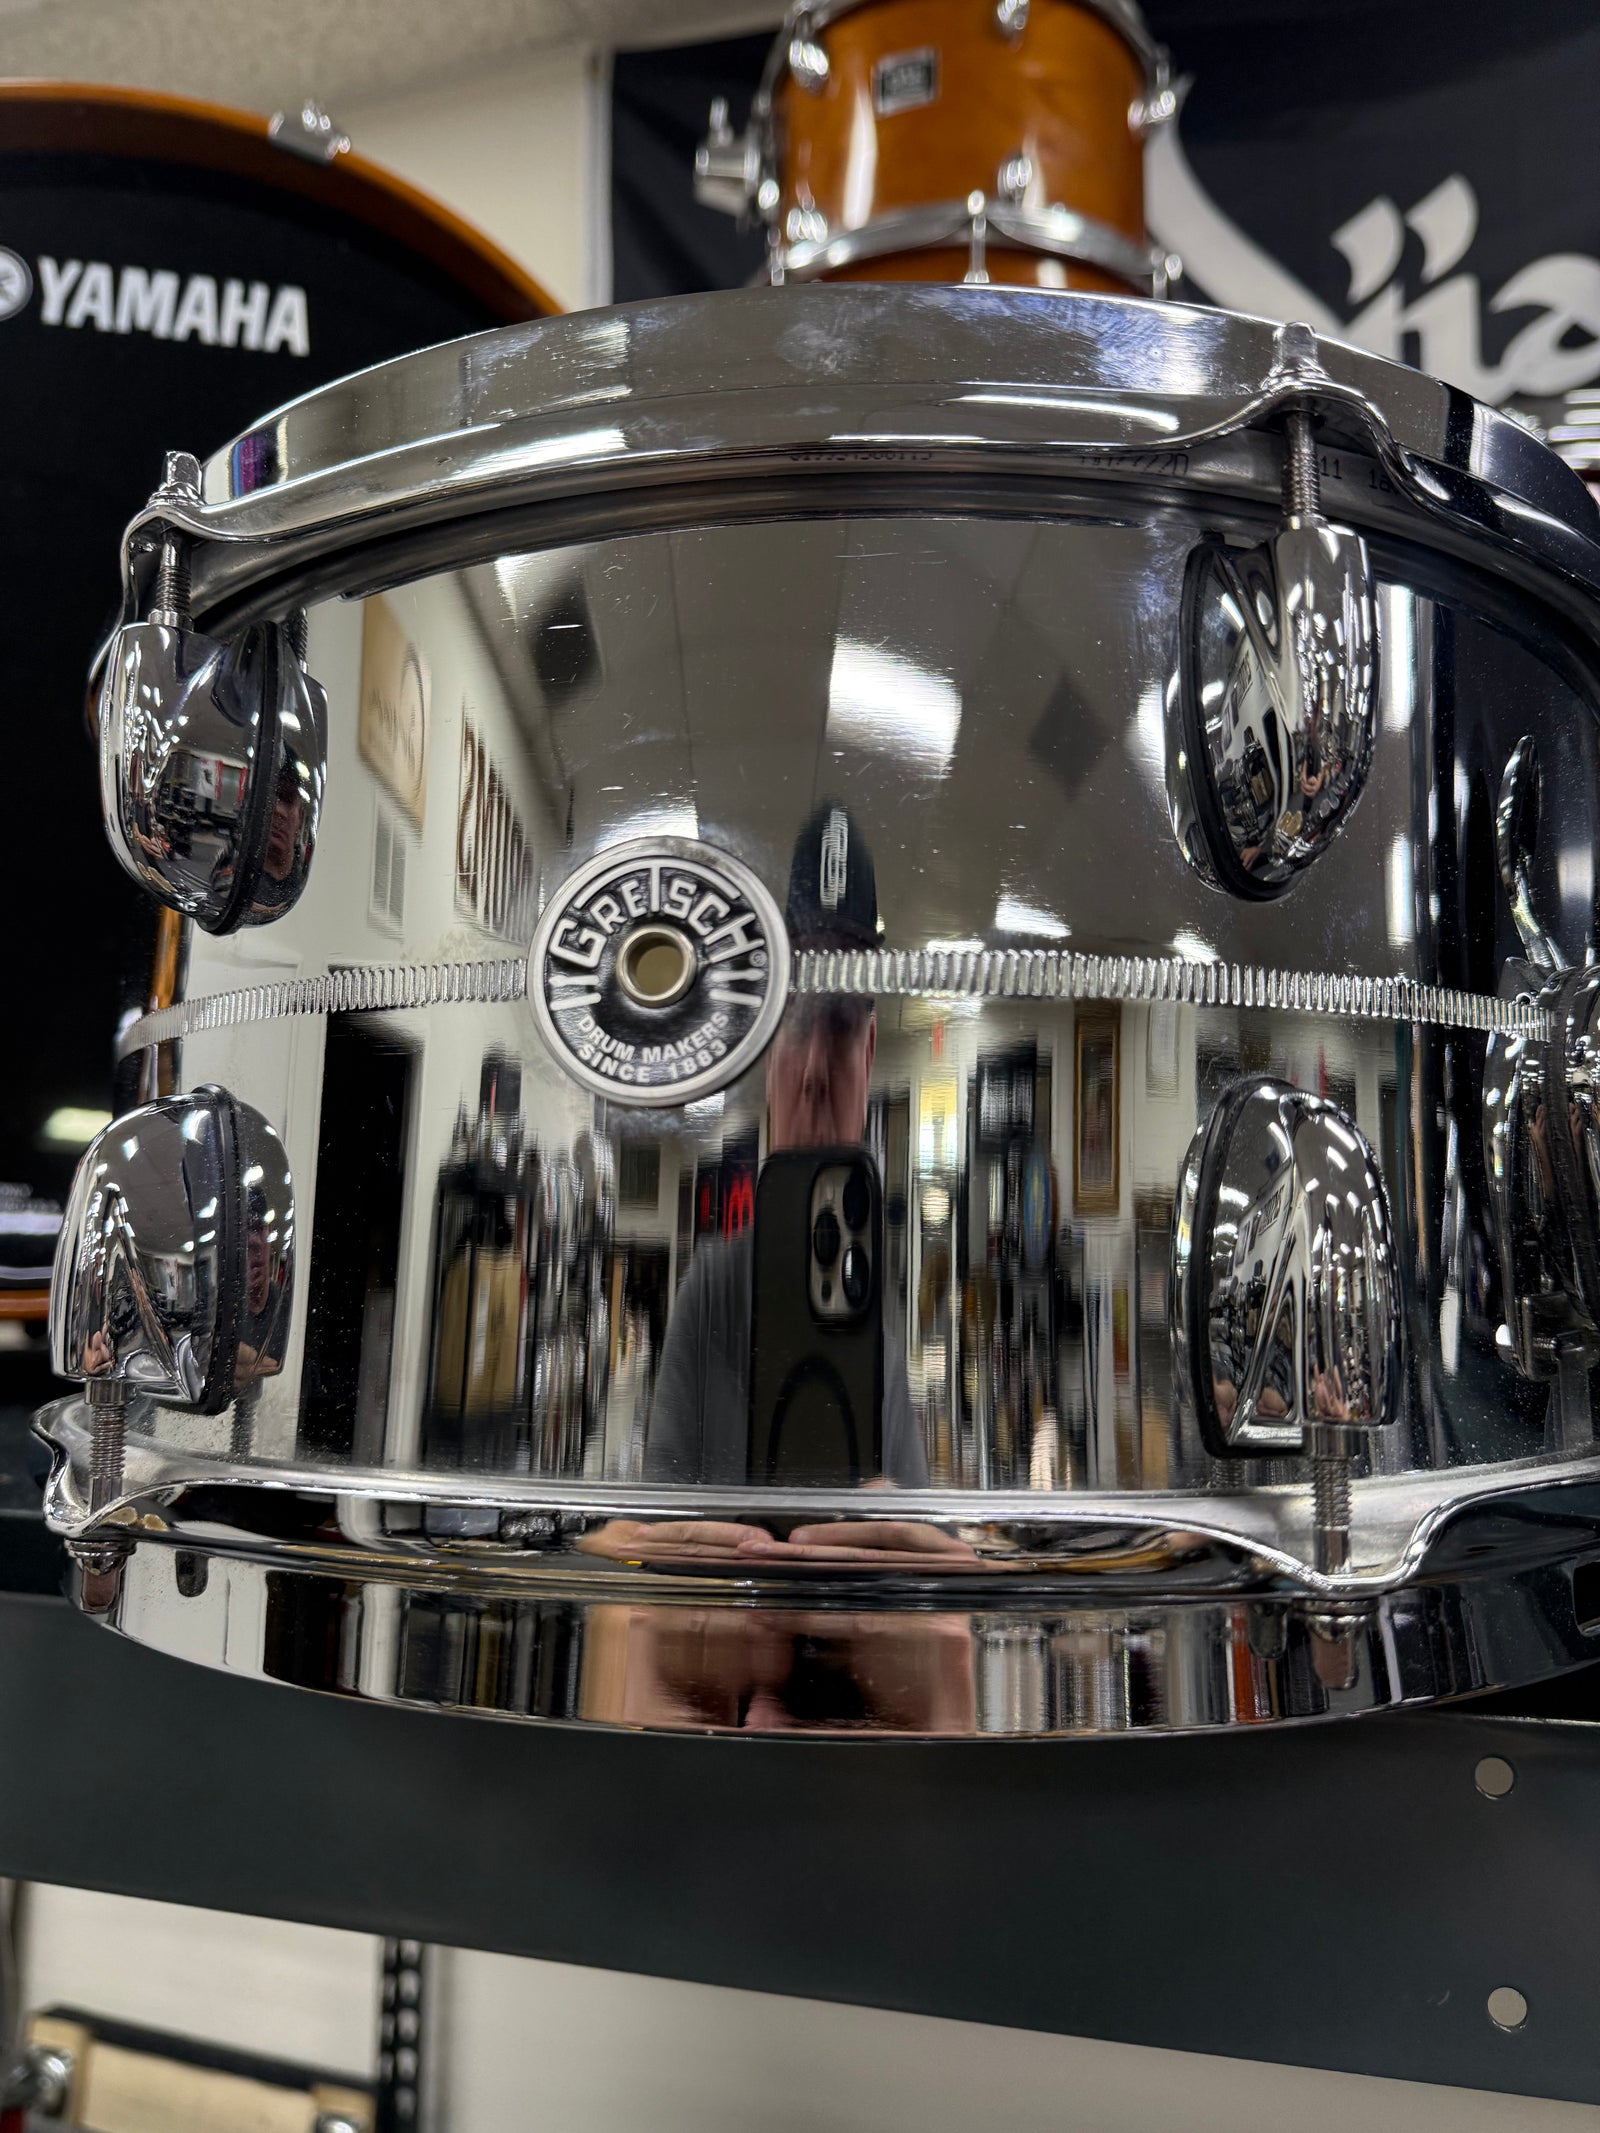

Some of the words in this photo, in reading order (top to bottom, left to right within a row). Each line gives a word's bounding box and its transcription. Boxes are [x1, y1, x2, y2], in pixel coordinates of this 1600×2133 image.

[37, 254, 310, 357] YAMAHA
[550, 858, 765, 969] GRETSCH
[577, 1015, 636, 1063] DRUM
[641, 1012, 730, 1065] MAKERS
[578, 1043, 651, 1084] SINCE
[667, 1038, 728, 1080] 1883
